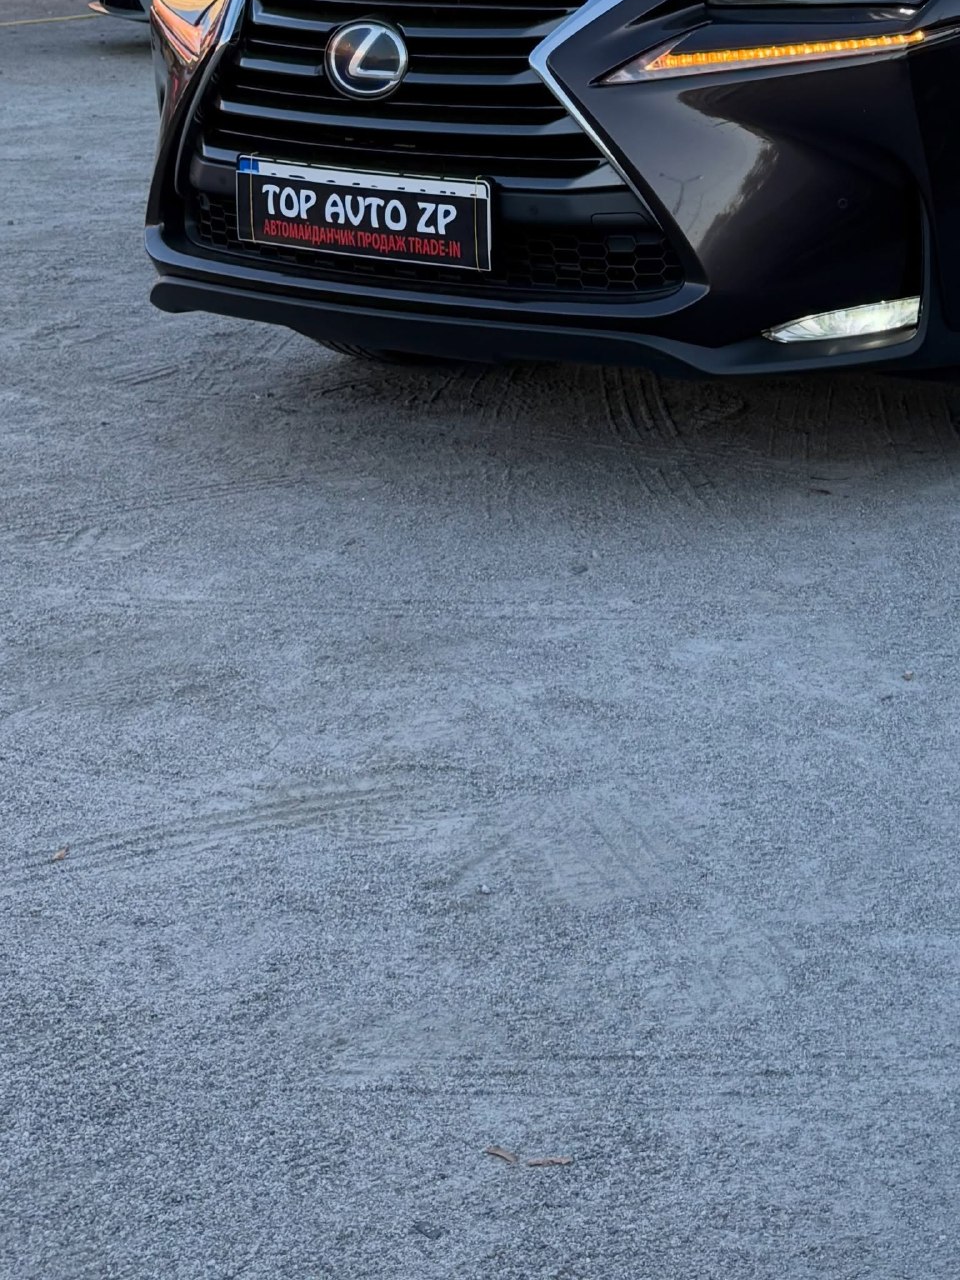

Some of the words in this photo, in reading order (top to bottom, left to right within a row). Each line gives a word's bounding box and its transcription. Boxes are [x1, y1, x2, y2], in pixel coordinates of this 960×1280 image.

[262, 184, 317, 219] TOP
[417, 202, 457, 235] ZP
[263, 218, 355, 245] АВТОМАЙДАНЧИК
[357, 230, 407, 254] ПРОДАЖ
[408, 236, 461, 258] TRADE-IN
